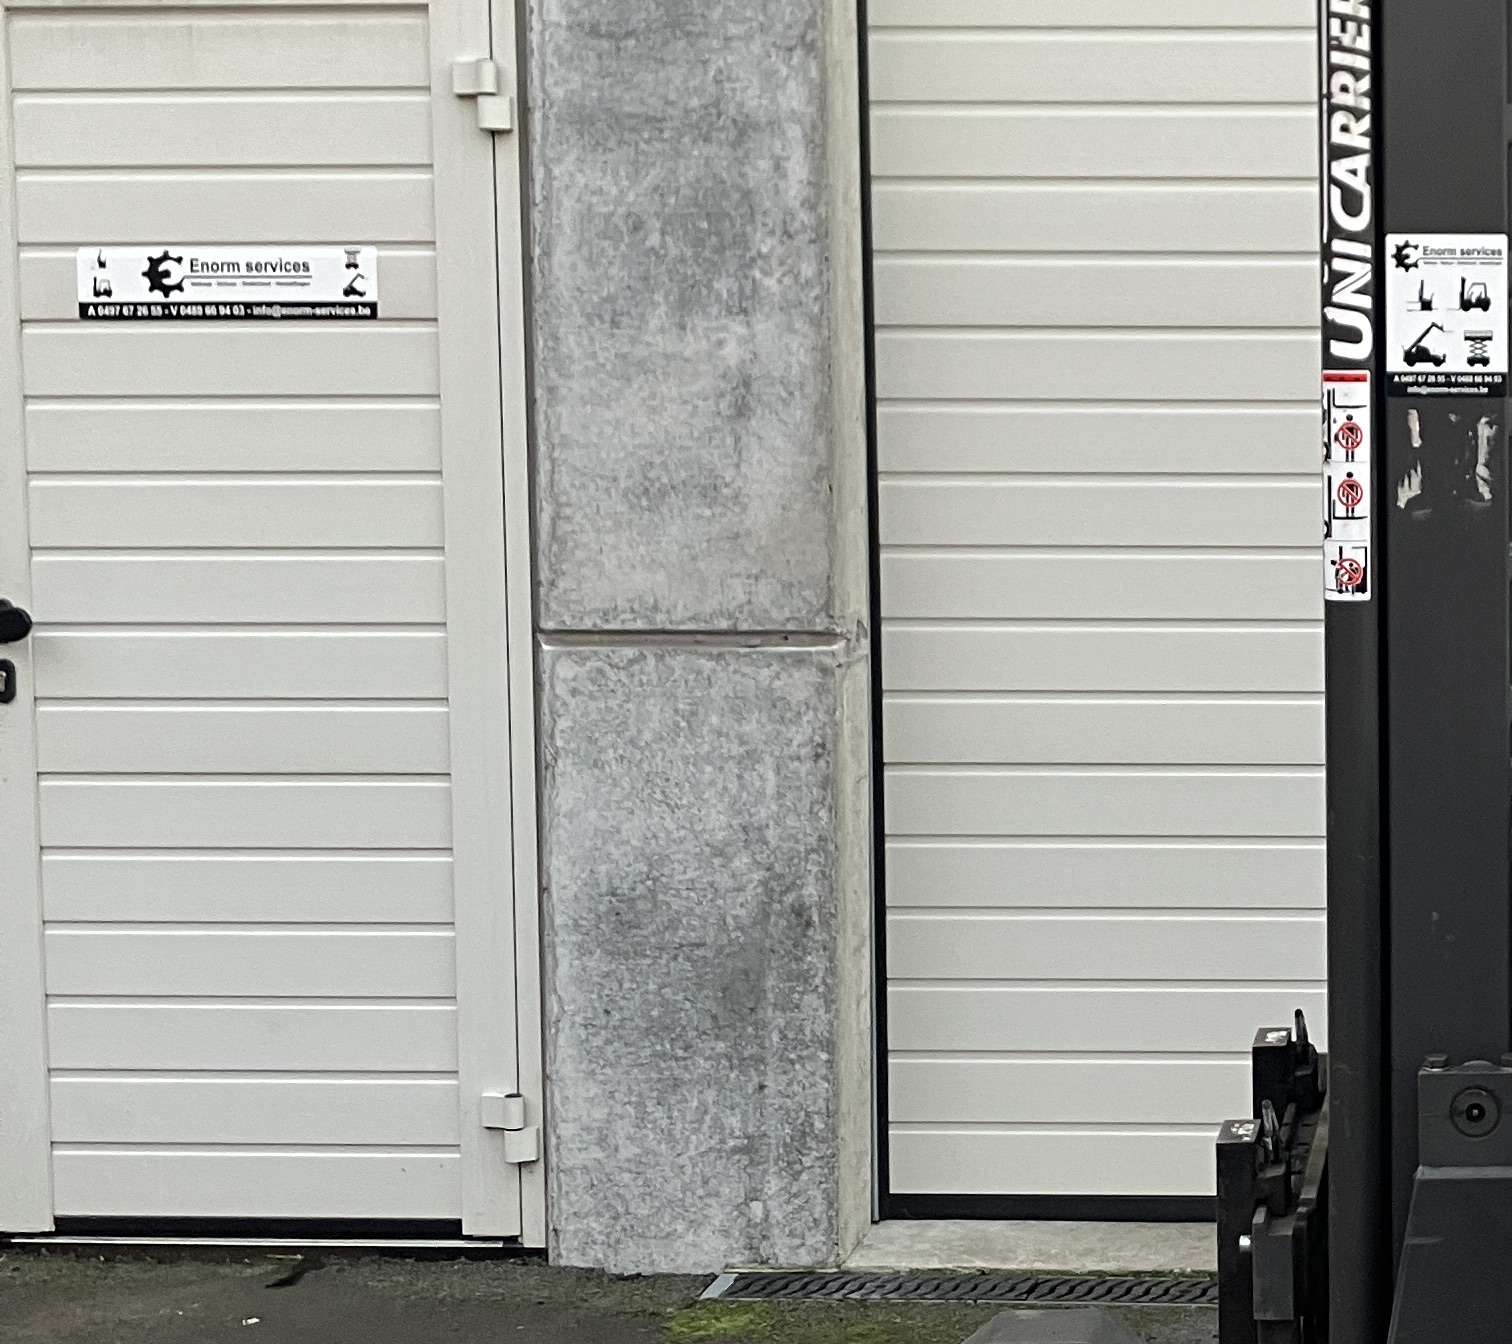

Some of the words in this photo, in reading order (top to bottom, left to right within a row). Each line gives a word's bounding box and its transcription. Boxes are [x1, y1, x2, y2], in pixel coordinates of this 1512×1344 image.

[1423, 245, 1457, 256] Enorm
[1460, 245, 1502, 256] services
[190, 258, 240, 273] Enorm
[245, 257, 310, 273] services
